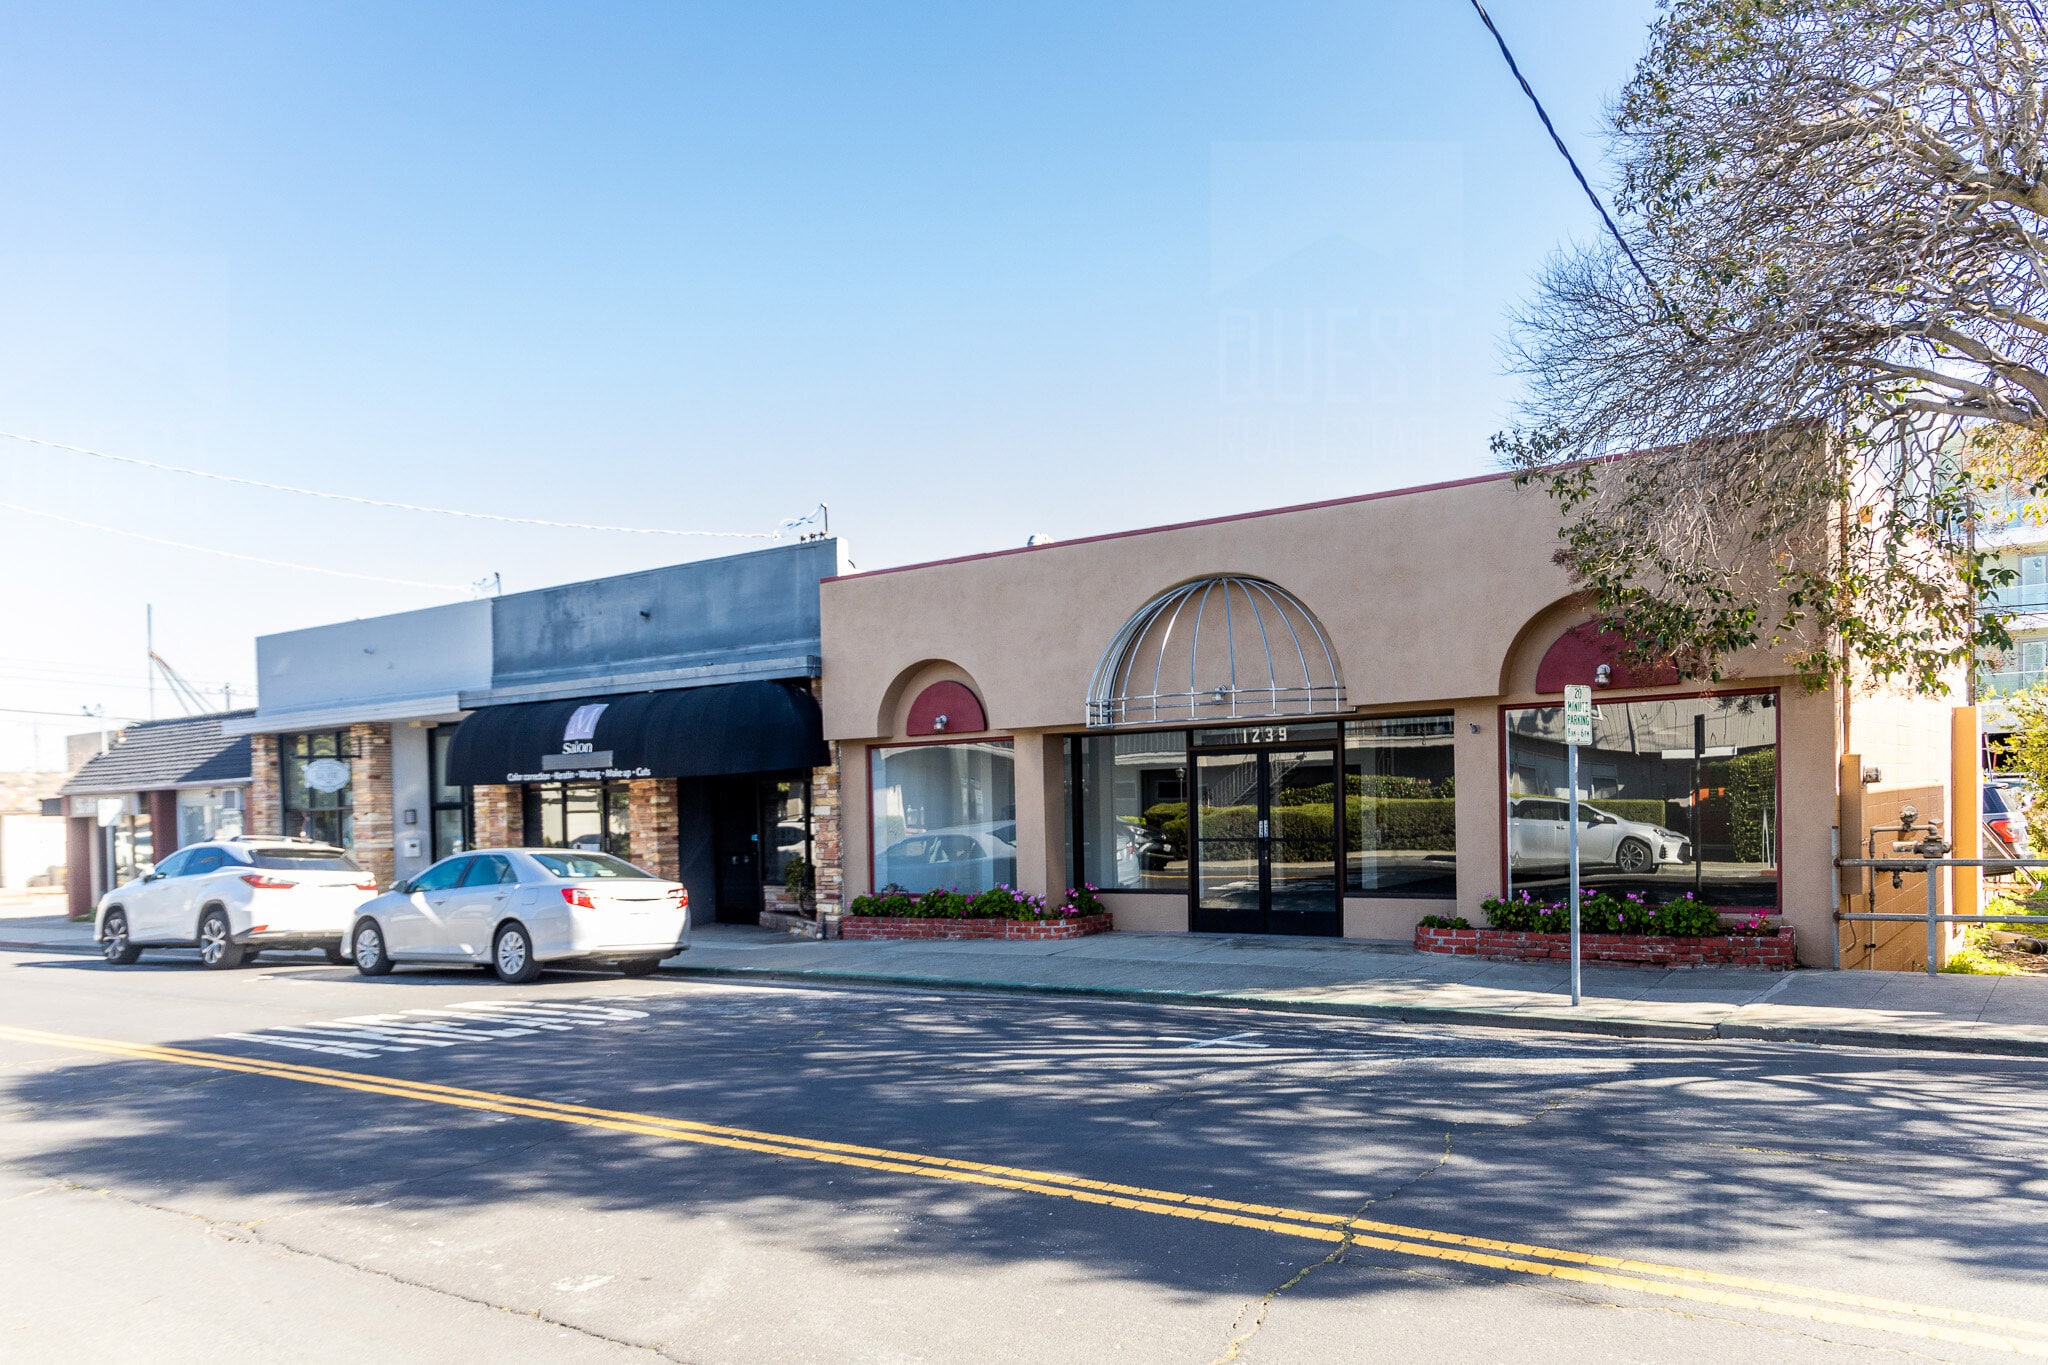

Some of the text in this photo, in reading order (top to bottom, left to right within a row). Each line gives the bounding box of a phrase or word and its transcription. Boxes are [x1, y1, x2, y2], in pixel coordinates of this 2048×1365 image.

[1574, 688, 1582, 699] 20
[1567, 701, 1589, 713] MINUTE
[1567, 714, 1590, 726] PARKING
[1243, 726, 1287, 744] 1239
[562, 741, 593, 755] Salon
